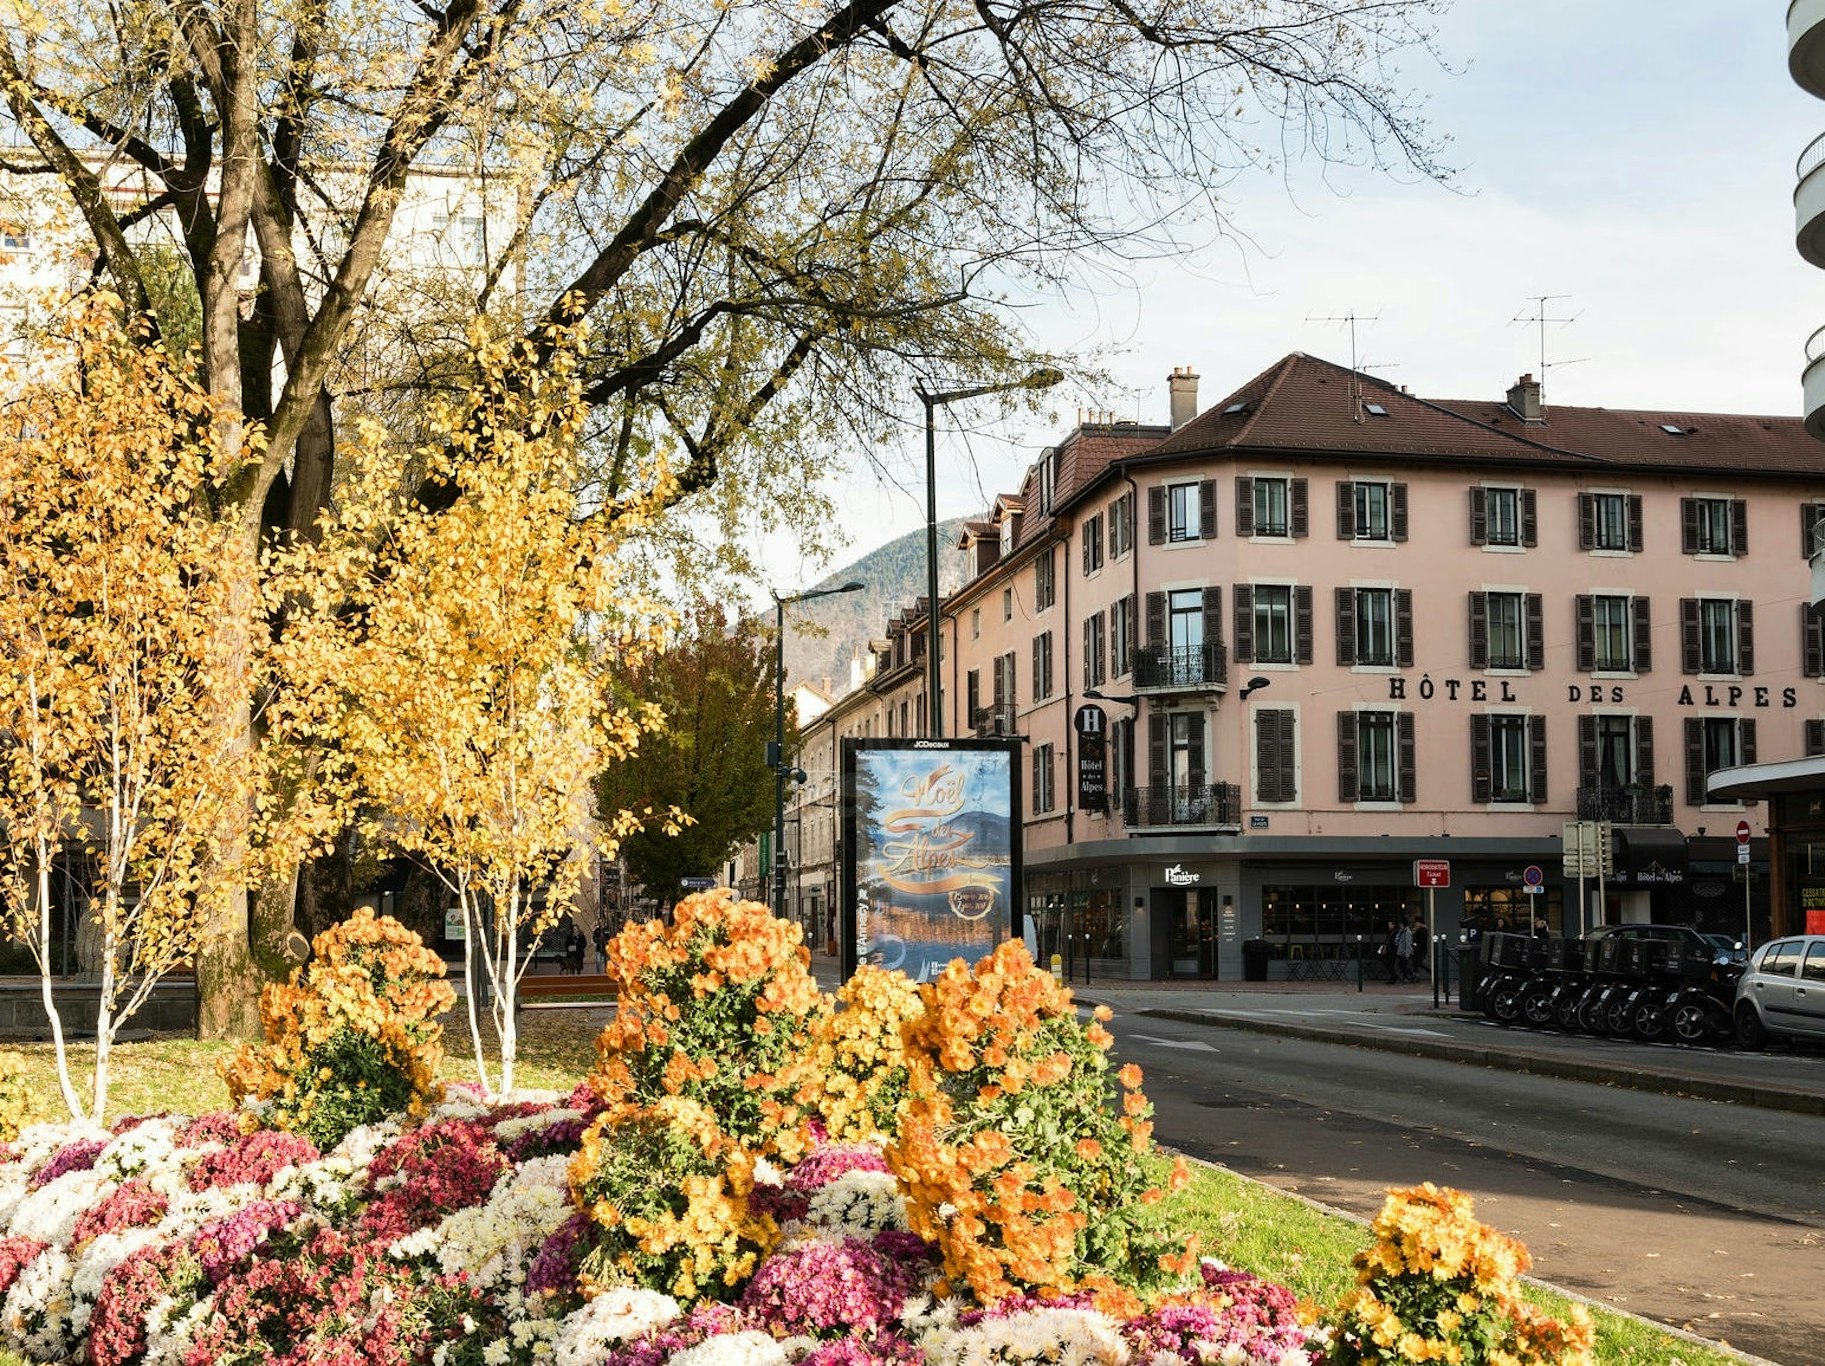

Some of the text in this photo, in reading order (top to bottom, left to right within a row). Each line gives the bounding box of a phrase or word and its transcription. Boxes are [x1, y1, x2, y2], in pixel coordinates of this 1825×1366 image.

[1389, 673, 1797, 708] HÔTEL DES ALPES
[1082, 709, 1101, 732] H
[914, 741, 950, 749] JCDecaux
[1081, 760, 1102, 770] Hôtel
[901, 765, 965, 806] Noël
[1081, 781, 1103, 793] Alpes
[883, 832, 985, 880] Alpes
[1165, 864, 1200, 885] Panière
[1470, 929, 1476, 937] P
